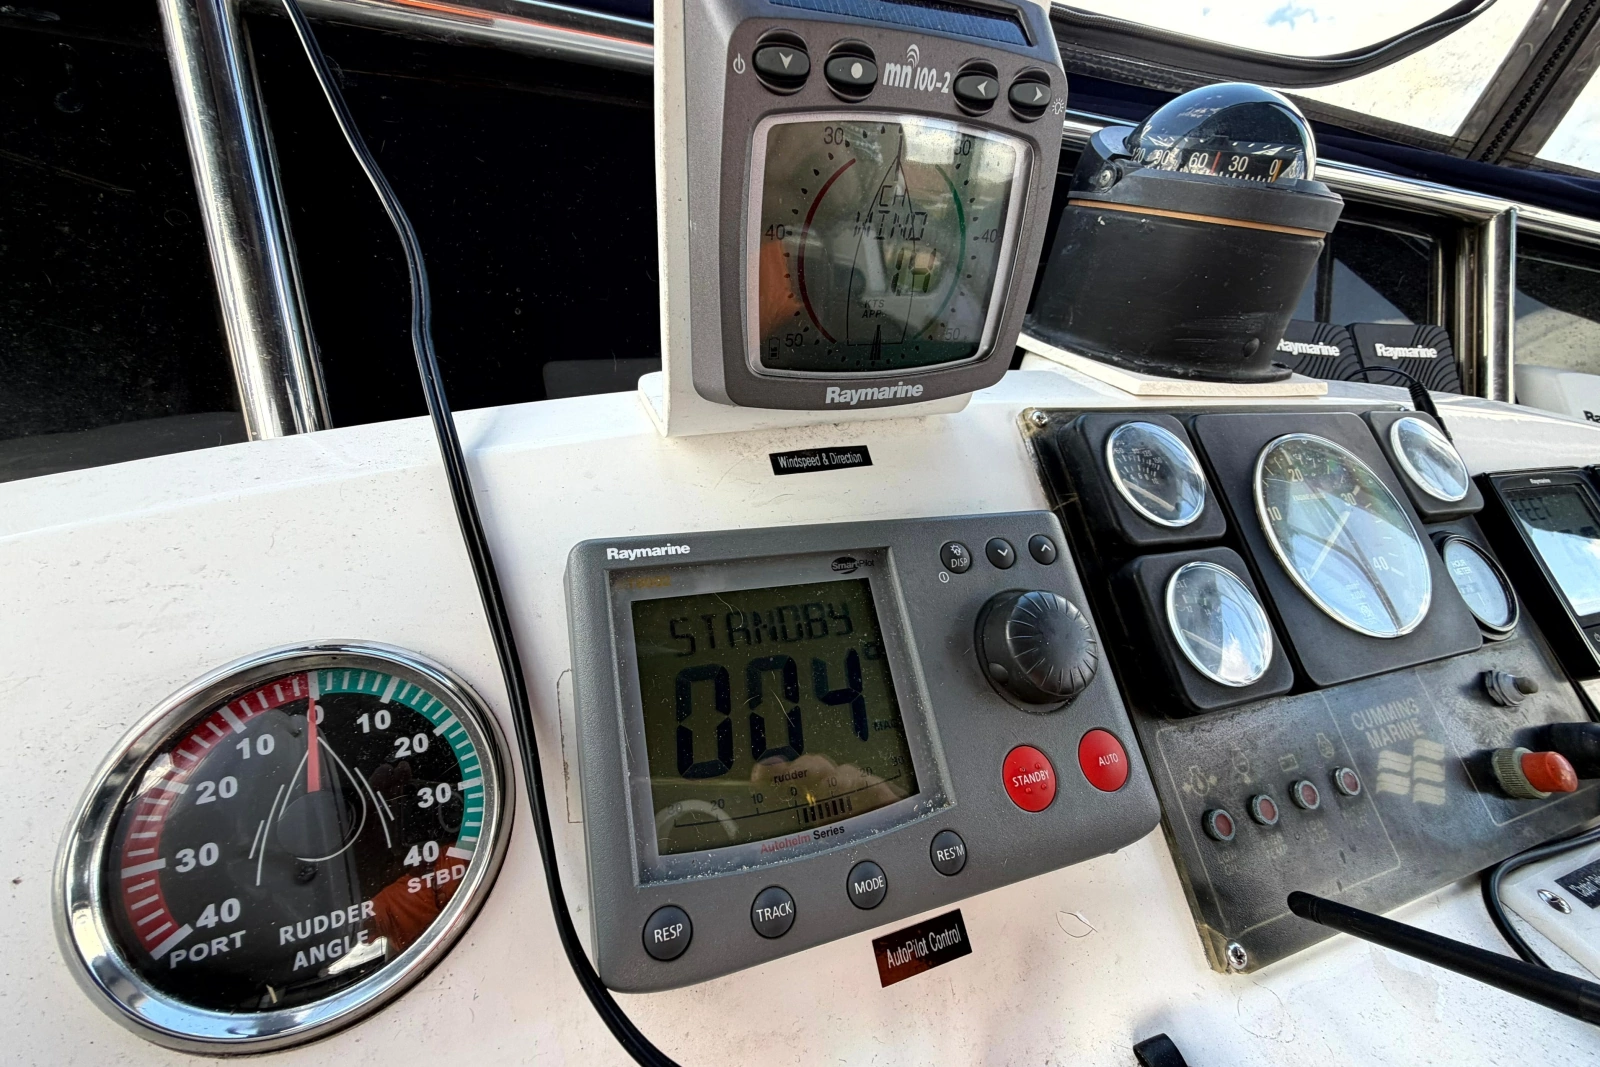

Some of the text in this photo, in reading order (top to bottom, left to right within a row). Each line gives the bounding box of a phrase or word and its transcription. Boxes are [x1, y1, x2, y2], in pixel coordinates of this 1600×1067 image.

[824, 127, 844, 145] 30
[1189, 152, 1208, 168] 60
[1228, 156, 1249, 172] 30
[765, 225, 786, 240] 40
[853, 210, 928, 240] WIND
[981, 229, 998, 243] 40
[785, 333, 804, 348] 50
[1374, 343, 1437, 359] Raymarine
[825, 382, 923, 405] Raymarine
[777, 451, 864, 469] Windspeed & Direction
[1287, 467, 1304, 482] 20
[1341, 492, 1357, 506] 30
[1267, 506, 1282, 521] 10
[606, 543, 691, 562] Raymarine
[951, 557, 968, 568] DISP
[1373, 556, 1389, 571] 40
[669, 602, 854, 657] STANDBY
[356, 711, 392, 733] 10
[675, 648, 869, 779] 004
[1351, 697, 1420, 731] CUMMINS
[1365, 717, 1424, 749] MARINE
[235, 733, 275, 760] 10
[394, 733, 429, 758] 20
[1098, 753, 1119, 766] AUTO
[773, 769, 808, 784] rudder
[1012, 769, 1050, 788] STANDBY
[195, 776, 239, 805] 20
[417, 783, 451, 808] 30
[710, 798, 725, 811] 20
[752, 794, 764, 805] 10
[790, 786, 798, 797] 0
[826, 776, 838, 788] 10
[860, 766, 873, 778] 20
[760, 824, 845, 854] Autohelm Series
[175, 842, 220, 873] 30
[403, 841, 440, 866] 40
[936, 844, 965, 862] RES'M
[407, 865, 466, 894] STBD
[854, 875, 885, 894] MODE
[196, 898, 241, 930] 40
[756, 901, 793, 922] TRACK
[279, 901, 376, 945] RUDDER
[653, 923, 684, 943] RESP
[169, 931, 247, 969] PORT
[886, 924, 962, 969] AutoPilot Control
